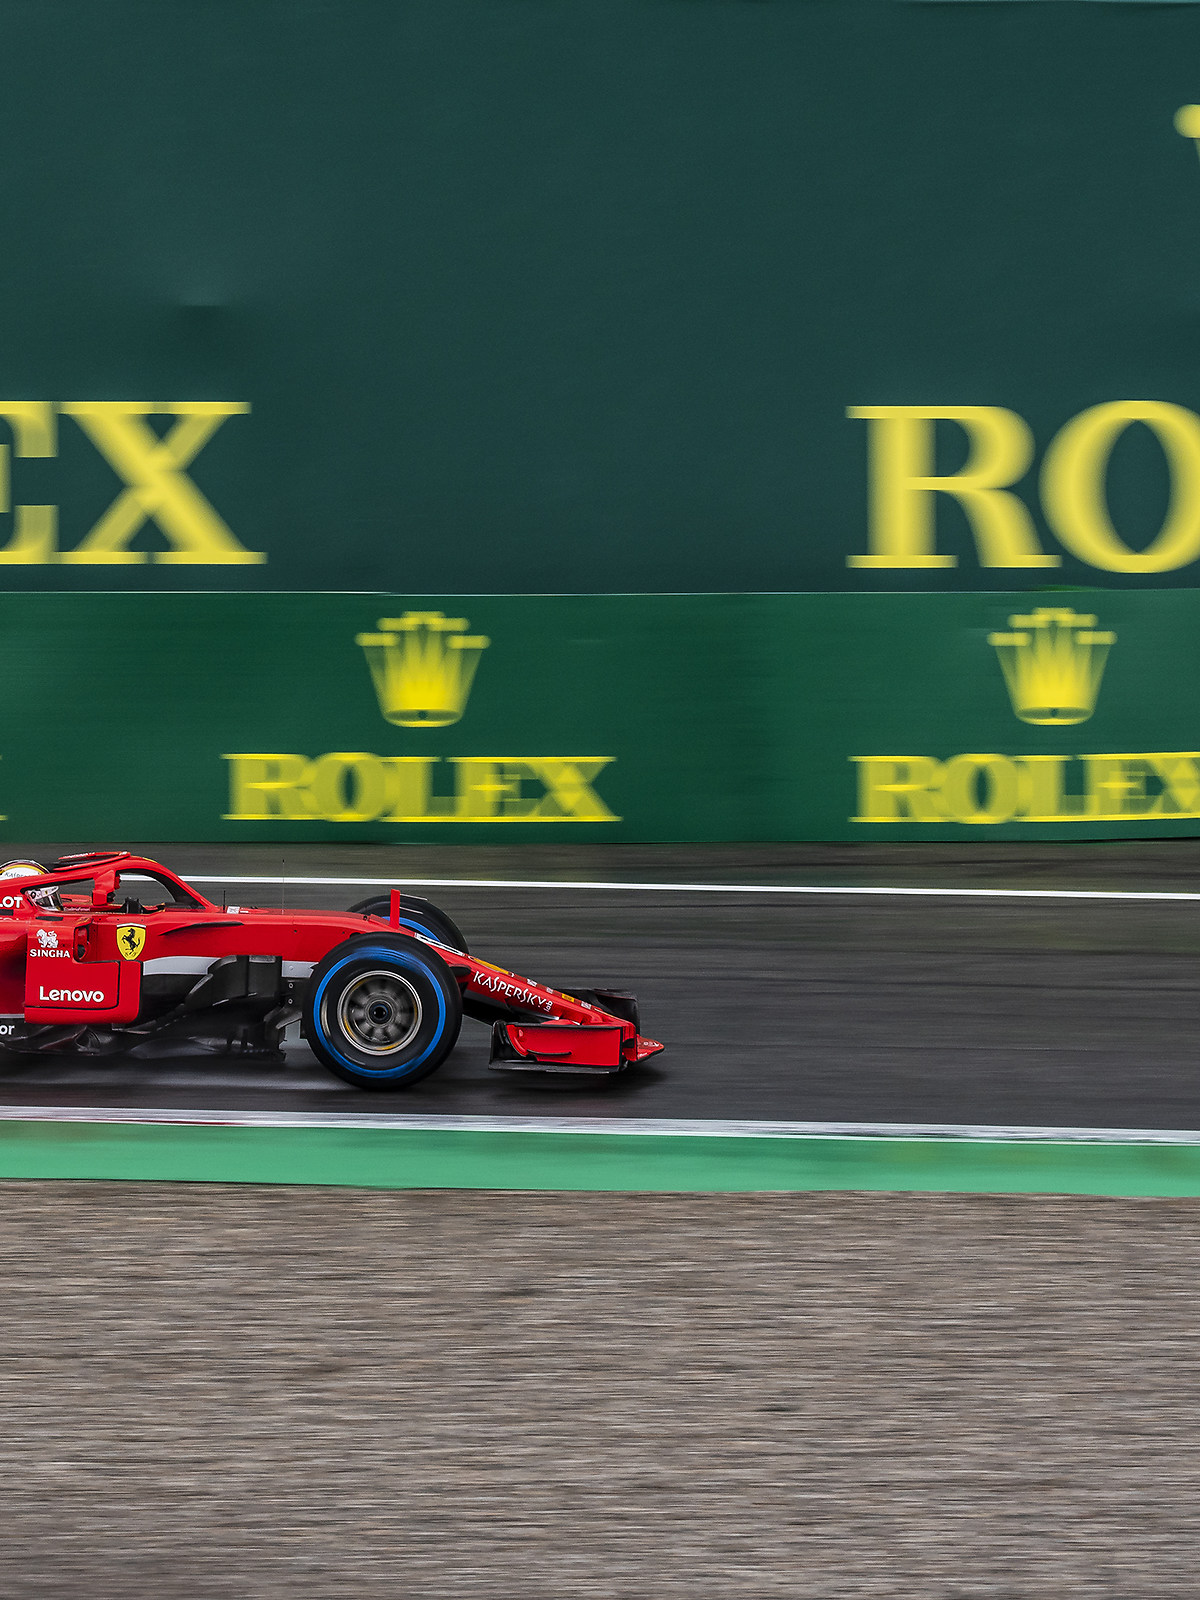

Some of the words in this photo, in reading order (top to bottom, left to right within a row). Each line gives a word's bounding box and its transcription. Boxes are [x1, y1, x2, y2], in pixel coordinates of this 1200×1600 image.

[220, 751, 621, 822] ROLEX
[30, 948, 70, 958] SINGHA
[39, 986, 104, 1002] Lenovo
[473, 970, 547, 1008] KASPERSKY
